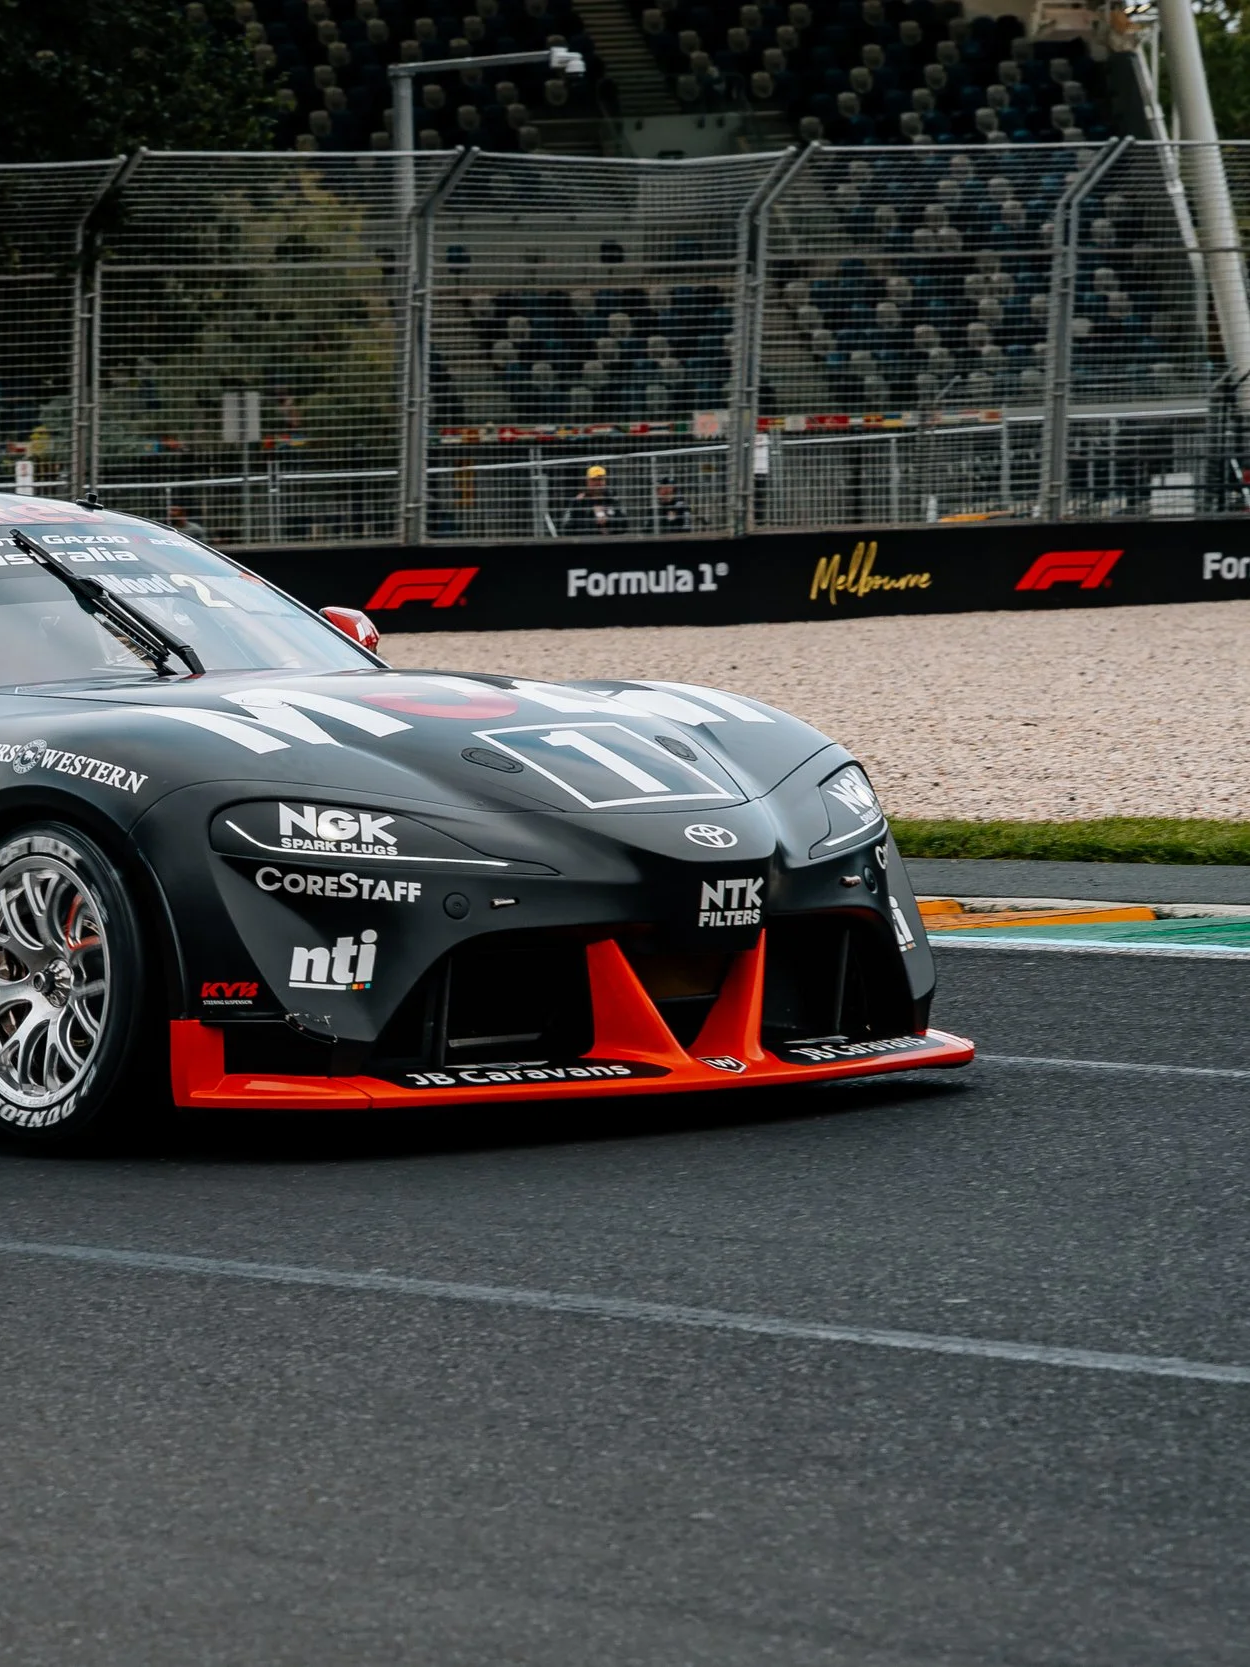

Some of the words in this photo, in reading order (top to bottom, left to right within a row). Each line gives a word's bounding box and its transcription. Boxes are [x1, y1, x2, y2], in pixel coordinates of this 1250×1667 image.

[567, 564, 694, 597] Formula
[810, 541, 933, 605] Melbourne
[1014, 549, 1125, 591] F1
[170, 573, 234, 608] 2
[364, 566, 480, 610] F1
[40, 748, 149, 794] WESTERN
[278, 802, 398, 845] NGK
[281, 837, 337, 852] SPARK
[340, 841, 398, 856] PLUGS
[700, 876, 765, 909] NTK
[698, 908, 761, 927] FILTERS
[289, 929, 378, 984] nti
[200, 982, 259, 998] KYB
[406, 1071, 456, 1086] JB
[459, 1064, 632, 1083] Caravans
